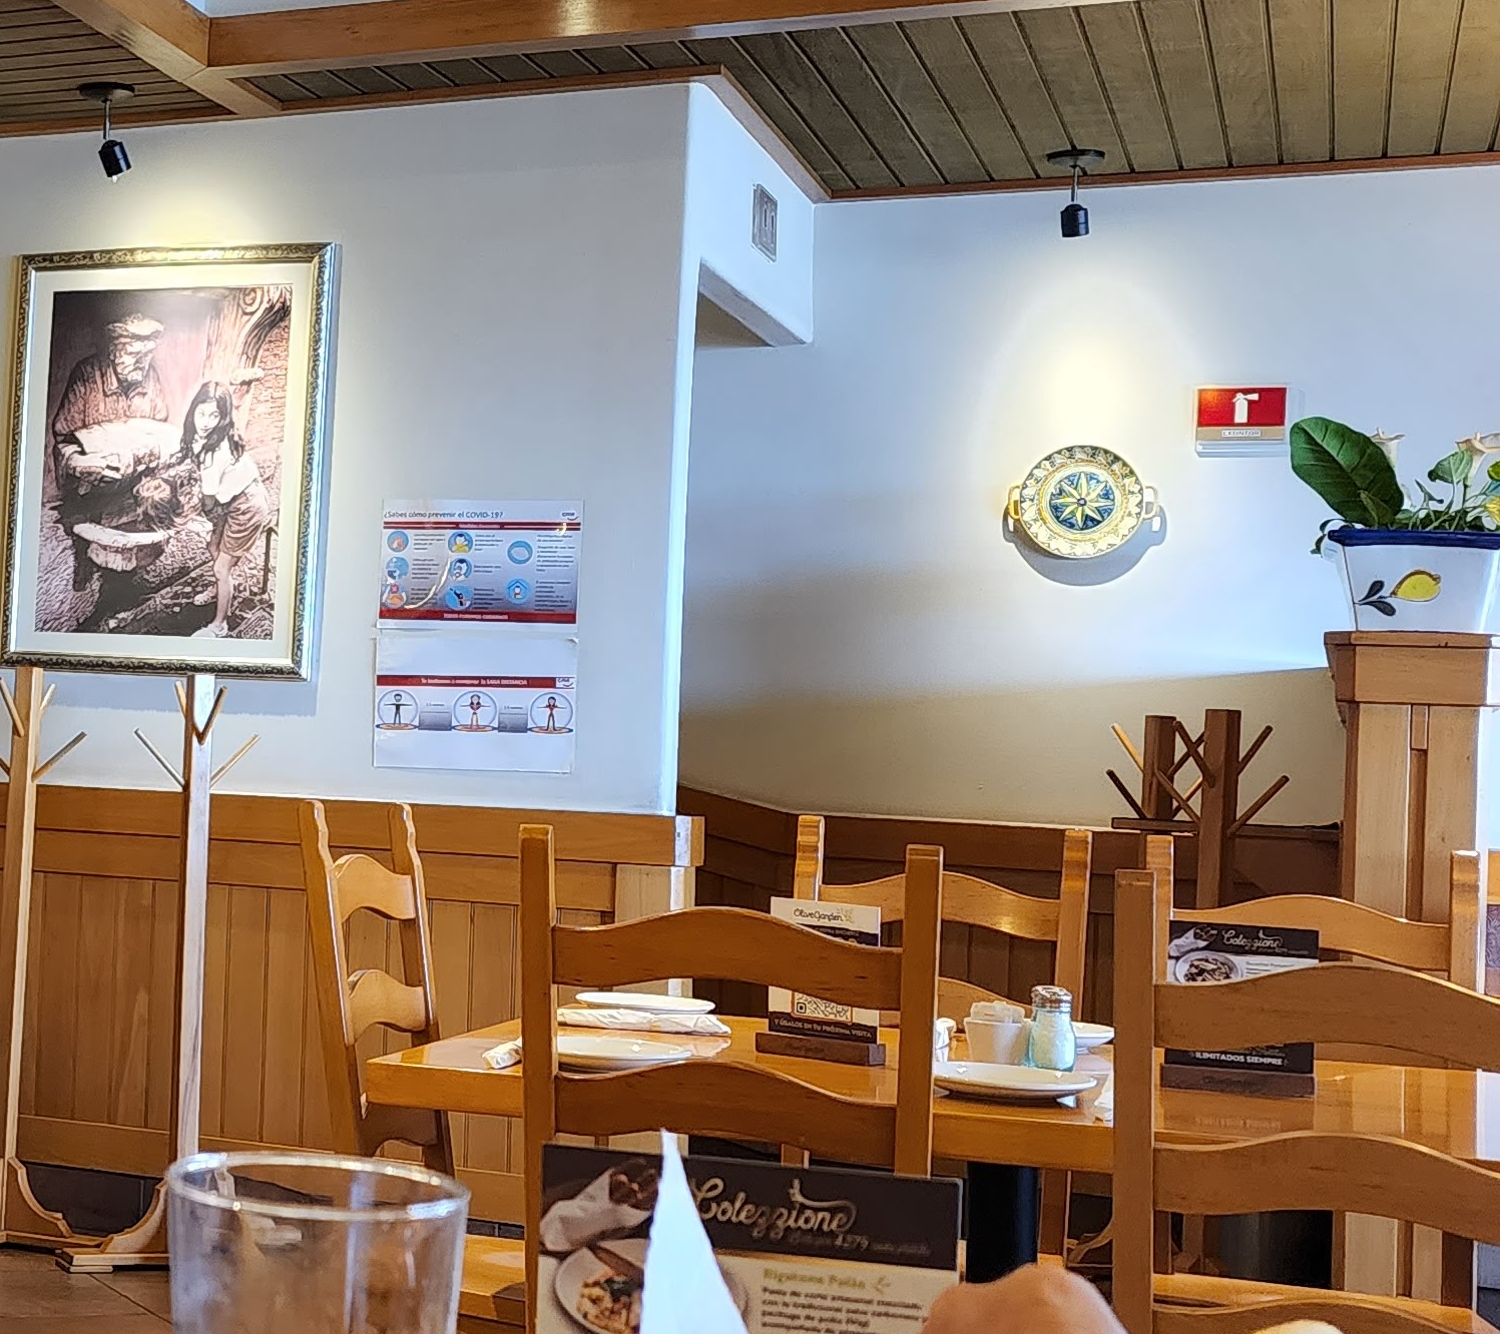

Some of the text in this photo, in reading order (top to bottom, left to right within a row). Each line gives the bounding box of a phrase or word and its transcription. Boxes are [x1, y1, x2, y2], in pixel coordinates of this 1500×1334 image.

[383, 511, 407, 519] ¿Sabes
[465, 511, 503, 519] COVID-19?
[1195, 1052, 1245, 1063] ILIMITADOS
[1246, 1055, 1283, 1066] SIEMPRE
